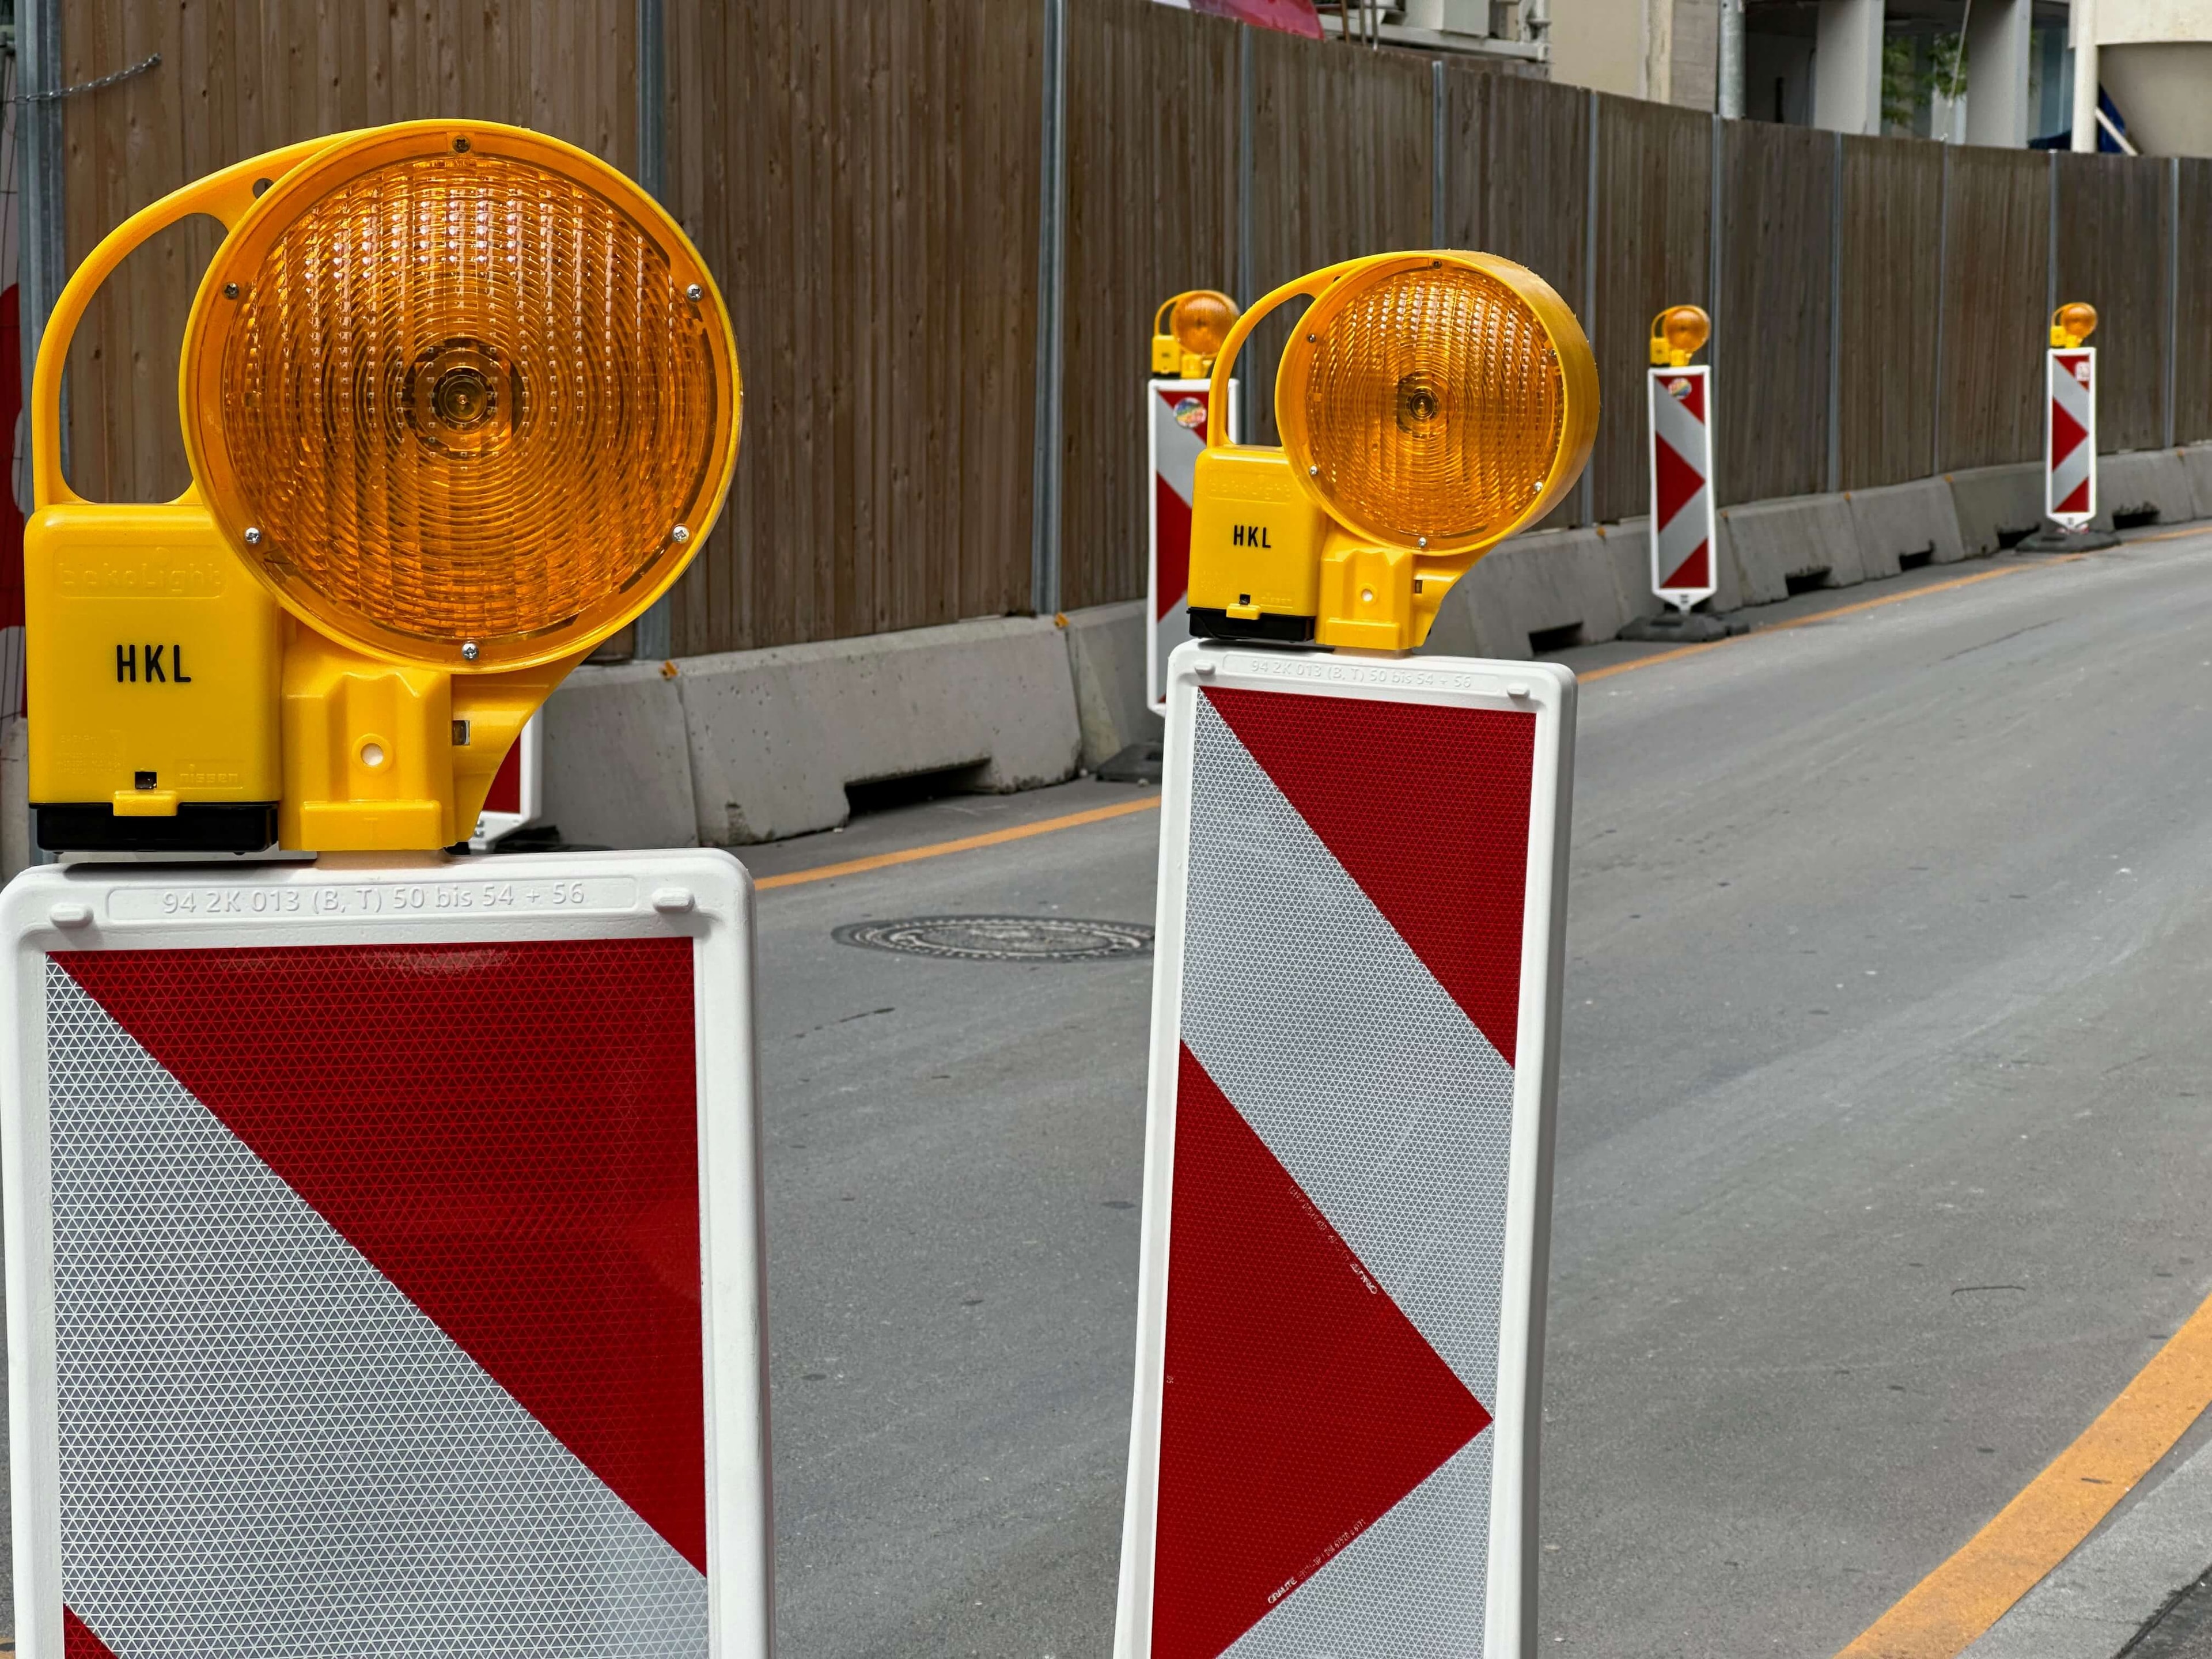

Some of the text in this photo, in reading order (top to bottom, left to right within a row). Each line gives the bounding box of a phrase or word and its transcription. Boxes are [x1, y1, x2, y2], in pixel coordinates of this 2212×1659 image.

[1233, 525, 1271, 548] HKL
[116, 644, 191, 683] HKL
[1252, 660, 1268, 672] 94
[1272, 662, 1291, 675] 2K
[1296, 664, 1321, 677] 013
[1370, 669, 1387, 682] 50
[1392, 670, 1412, 684] bis
[1416, 672, 1434, 685] 54
[1454, 675, 1471, 688] 56
[162, 881, 585, 914] 94 2K 013 (B, T) 50 bis 54 + 56
